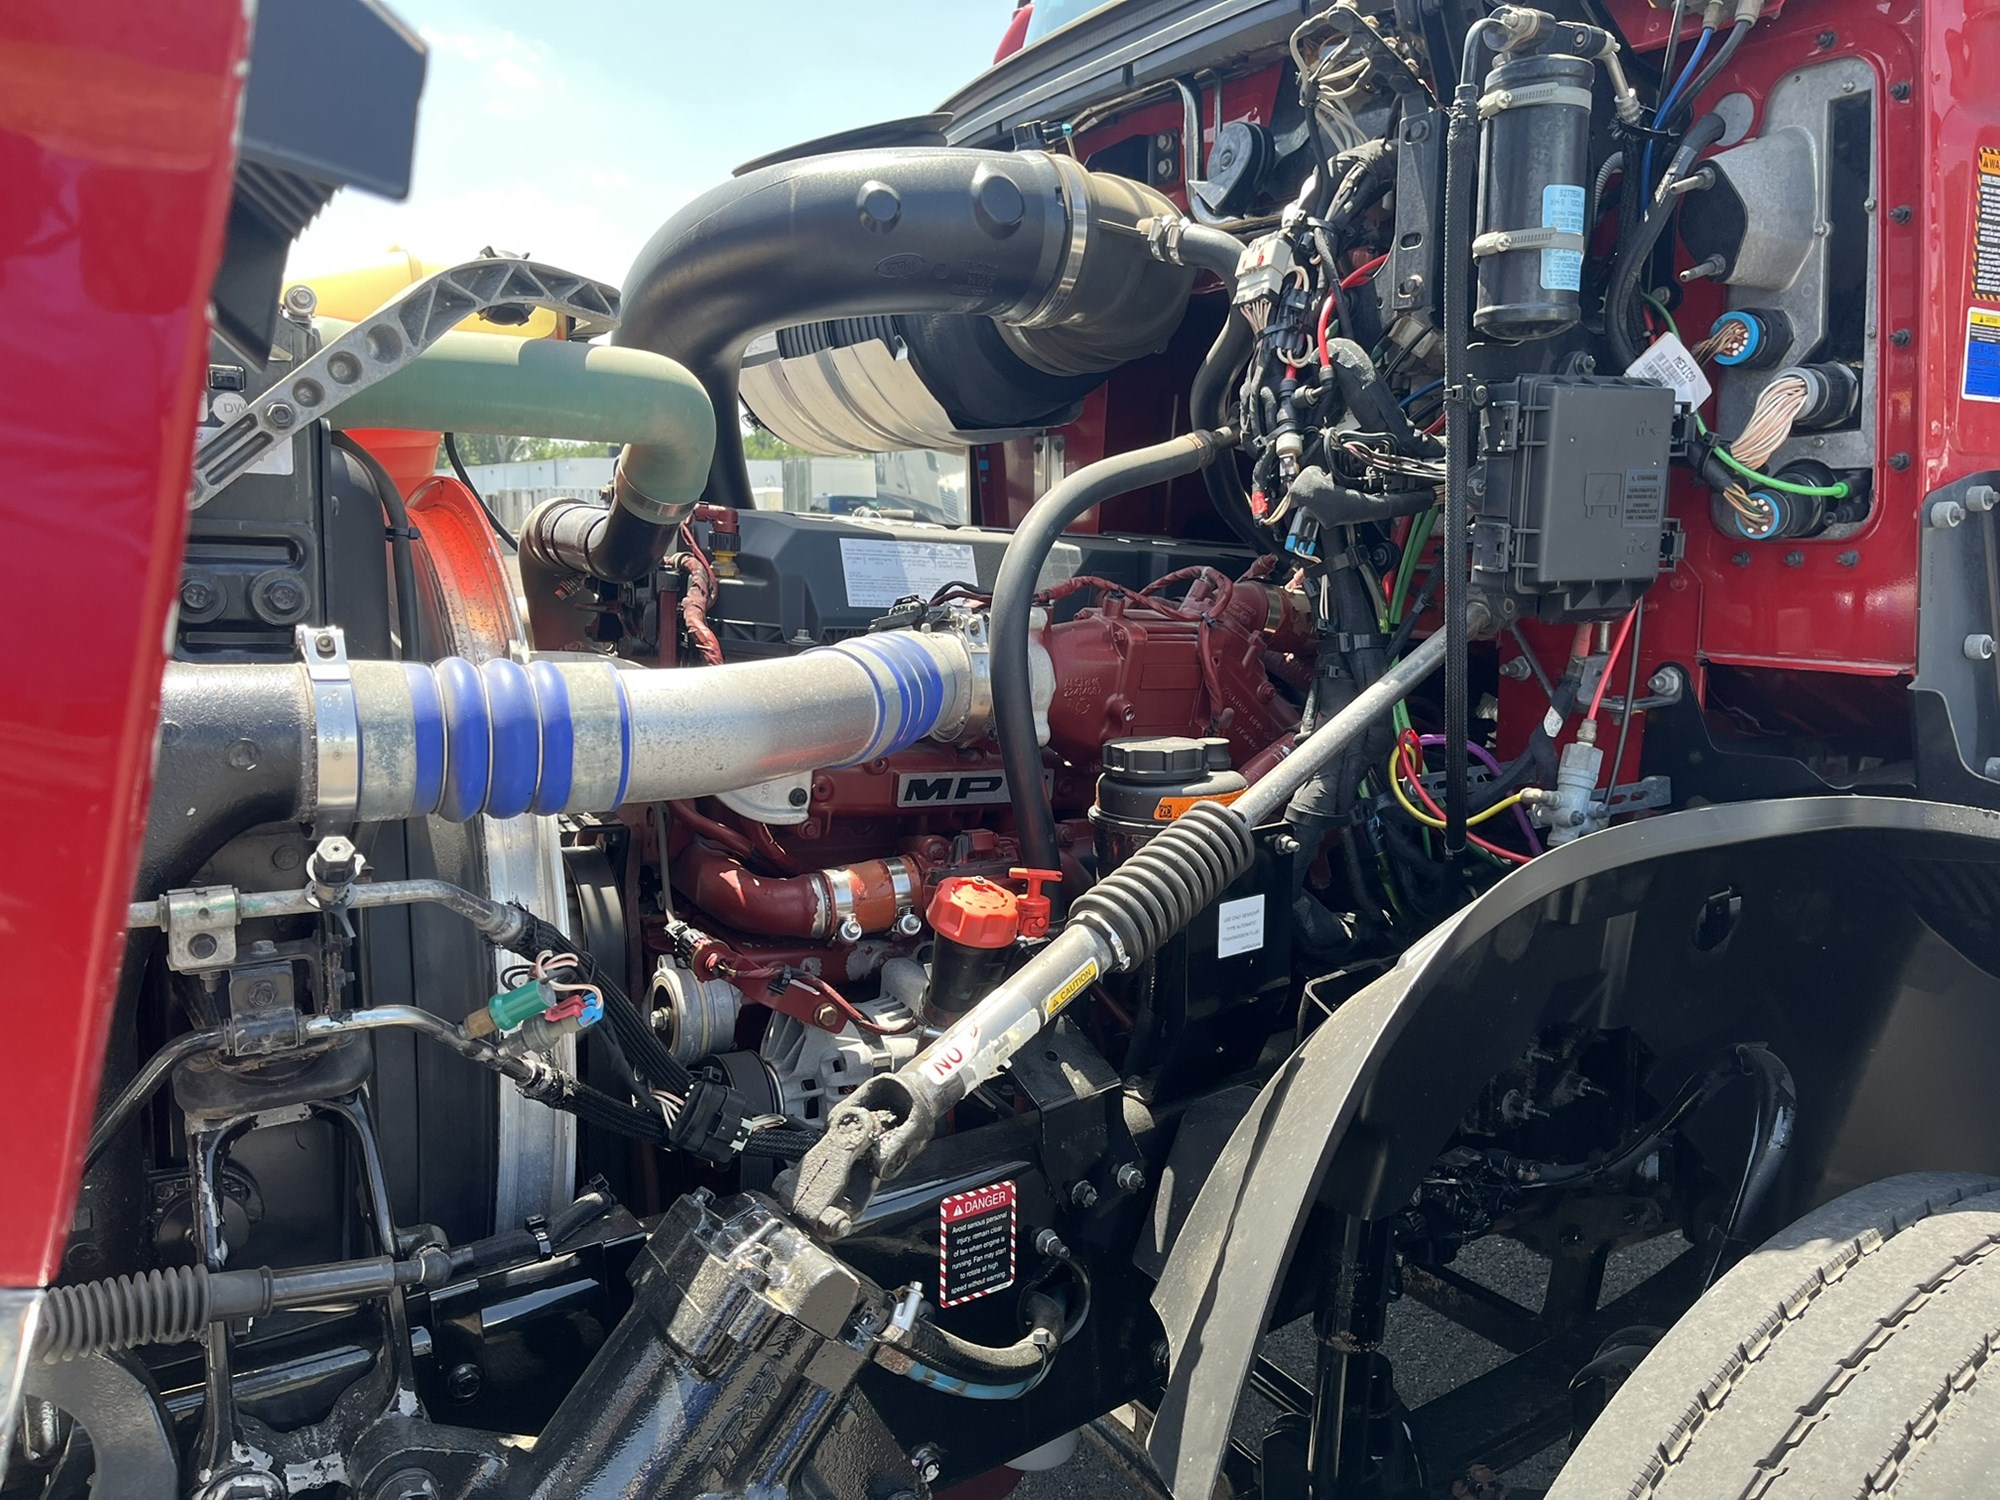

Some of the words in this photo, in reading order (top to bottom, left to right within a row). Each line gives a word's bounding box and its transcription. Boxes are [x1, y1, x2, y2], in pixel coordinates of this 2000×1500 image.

[1673, 355, 1697, 383] MEXICO
[904, 776, 1049, 802] MP
[1060, 968, 1092, 1000] CAUTION
[965, 1191, 1006, 1213] DANGER
[952, 1224, 967, 1234] Avoid
[967, 1219, 986, 1230] serious
[986, 1211, 1008, 1225] personal
[972, 1229, 990, 1240] remain
[990, 1225, 1003, 1234] clear
[953, 1250, 960, 1258] of
[960, 1247, 969, 1256] fan
[969, 1243, 983, 1253] when
[983, 1238, 1000, 1248] engine
[973, 1255, 984, 1263] Fan
[984, 1251, 995, 1260] may
[995, 1247, 1007, 1256] start
[966, 1268, 981, 1278] rotate
[987, 1261, 999, 1270] high
[951, 1283, 967, 1294] speed
[967, 1277, 986, 1289] without
